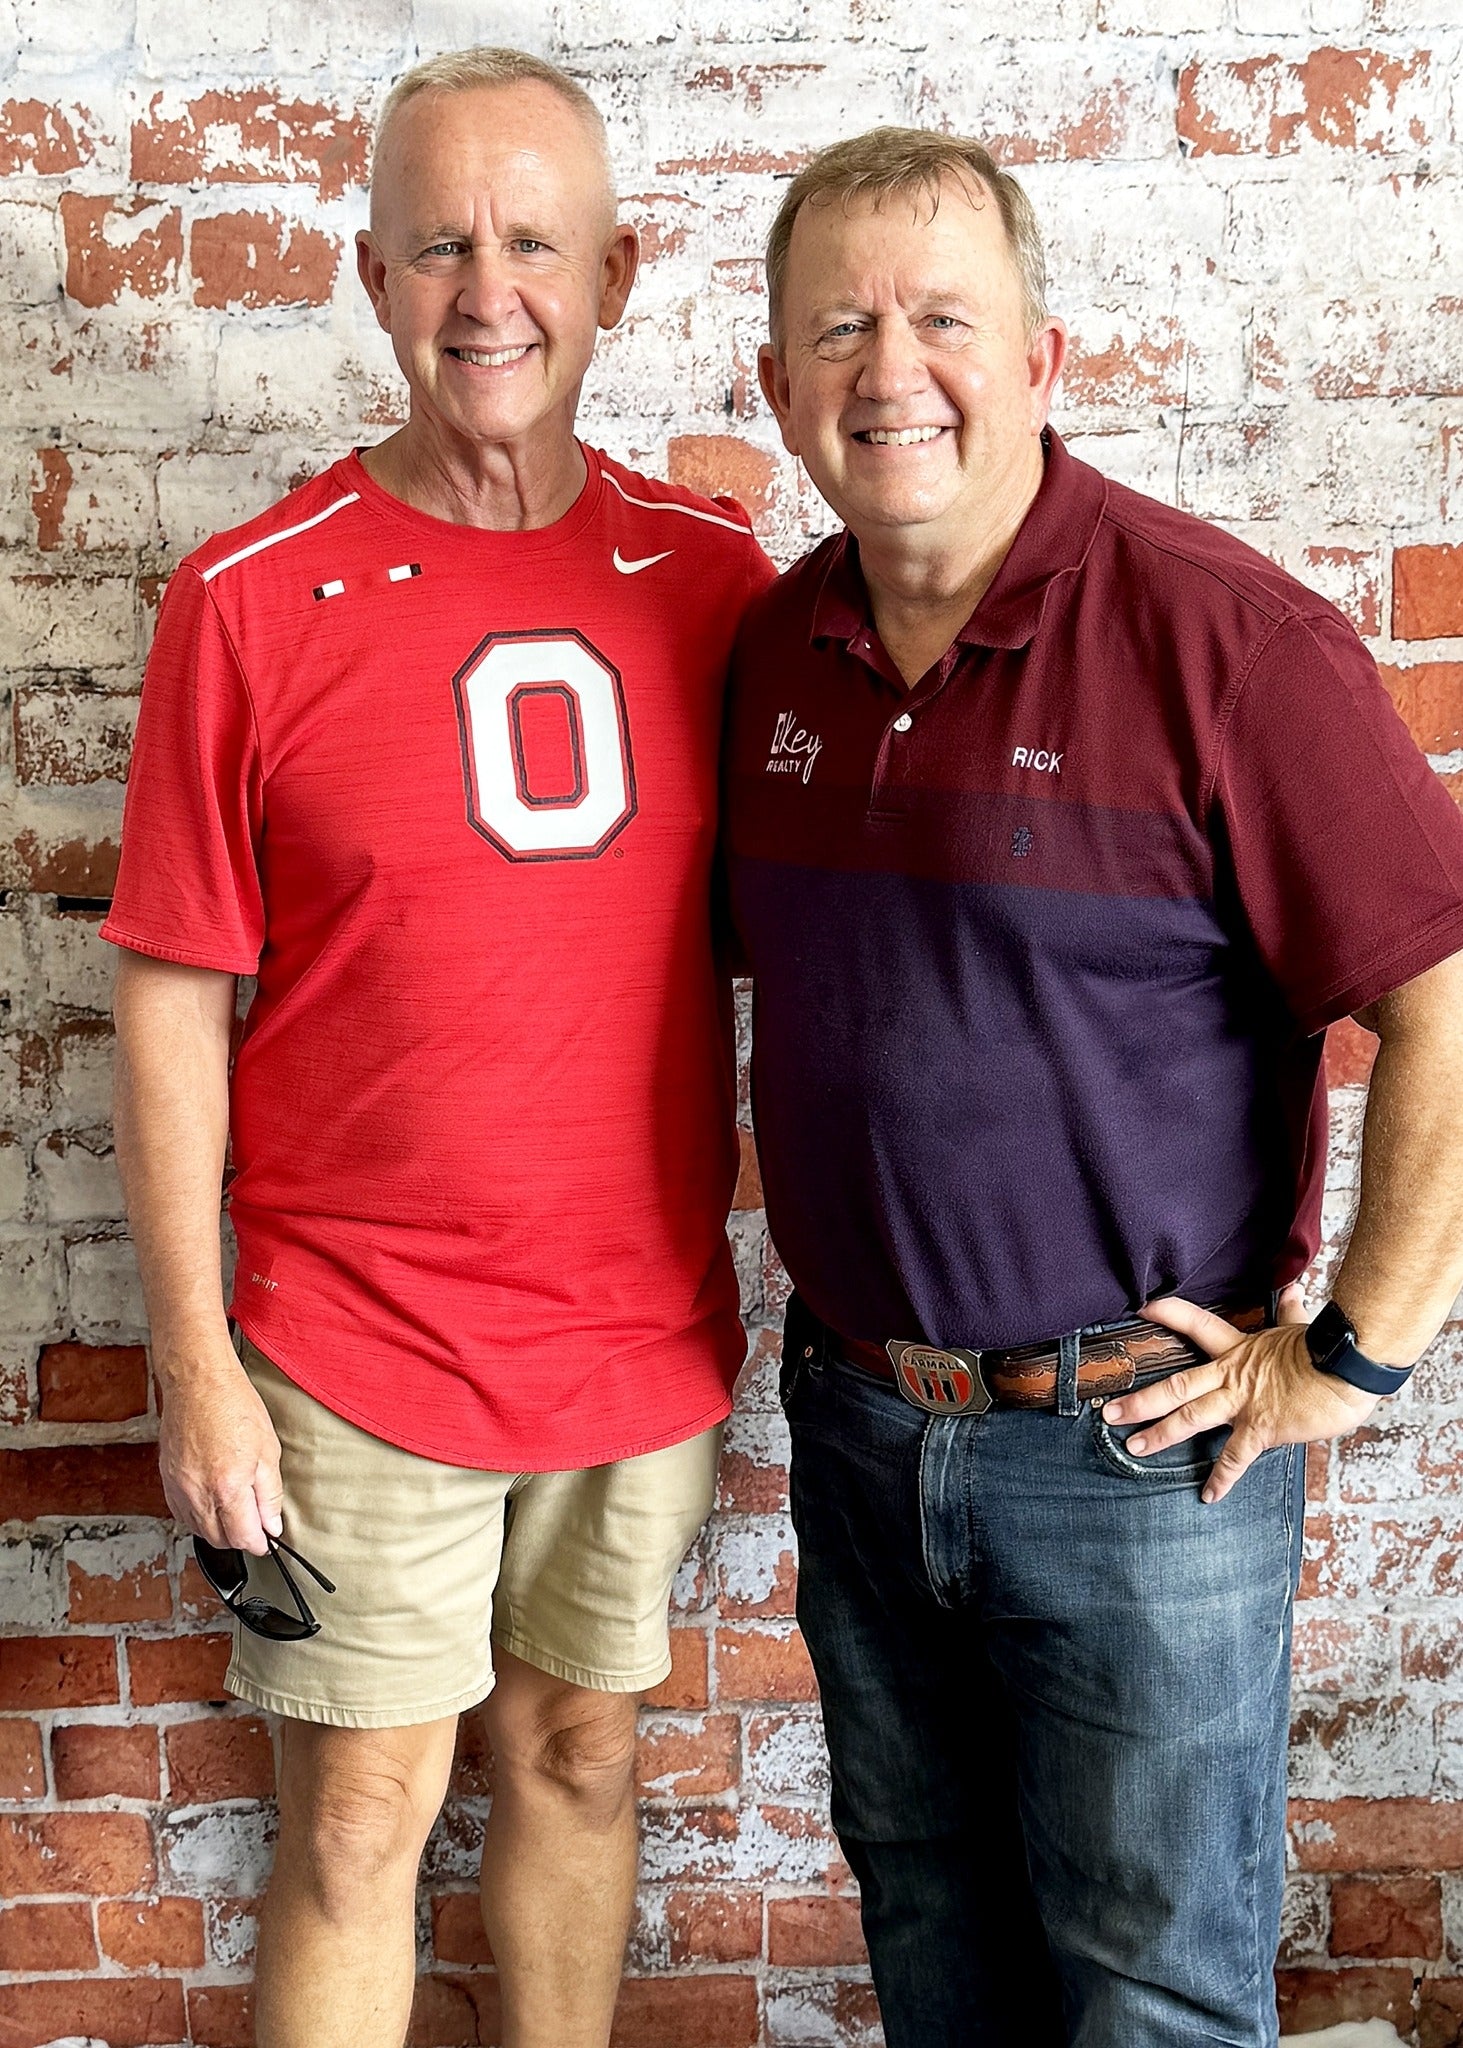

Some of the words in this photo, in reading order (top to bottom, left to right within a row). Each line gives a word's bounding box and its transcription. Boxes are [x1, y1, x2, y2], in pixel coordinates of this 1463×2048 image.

[452, 628, 639, 863] O
[765, 759, 802, 773] REALTY
[1011, 746, 1064, 774] RICK
